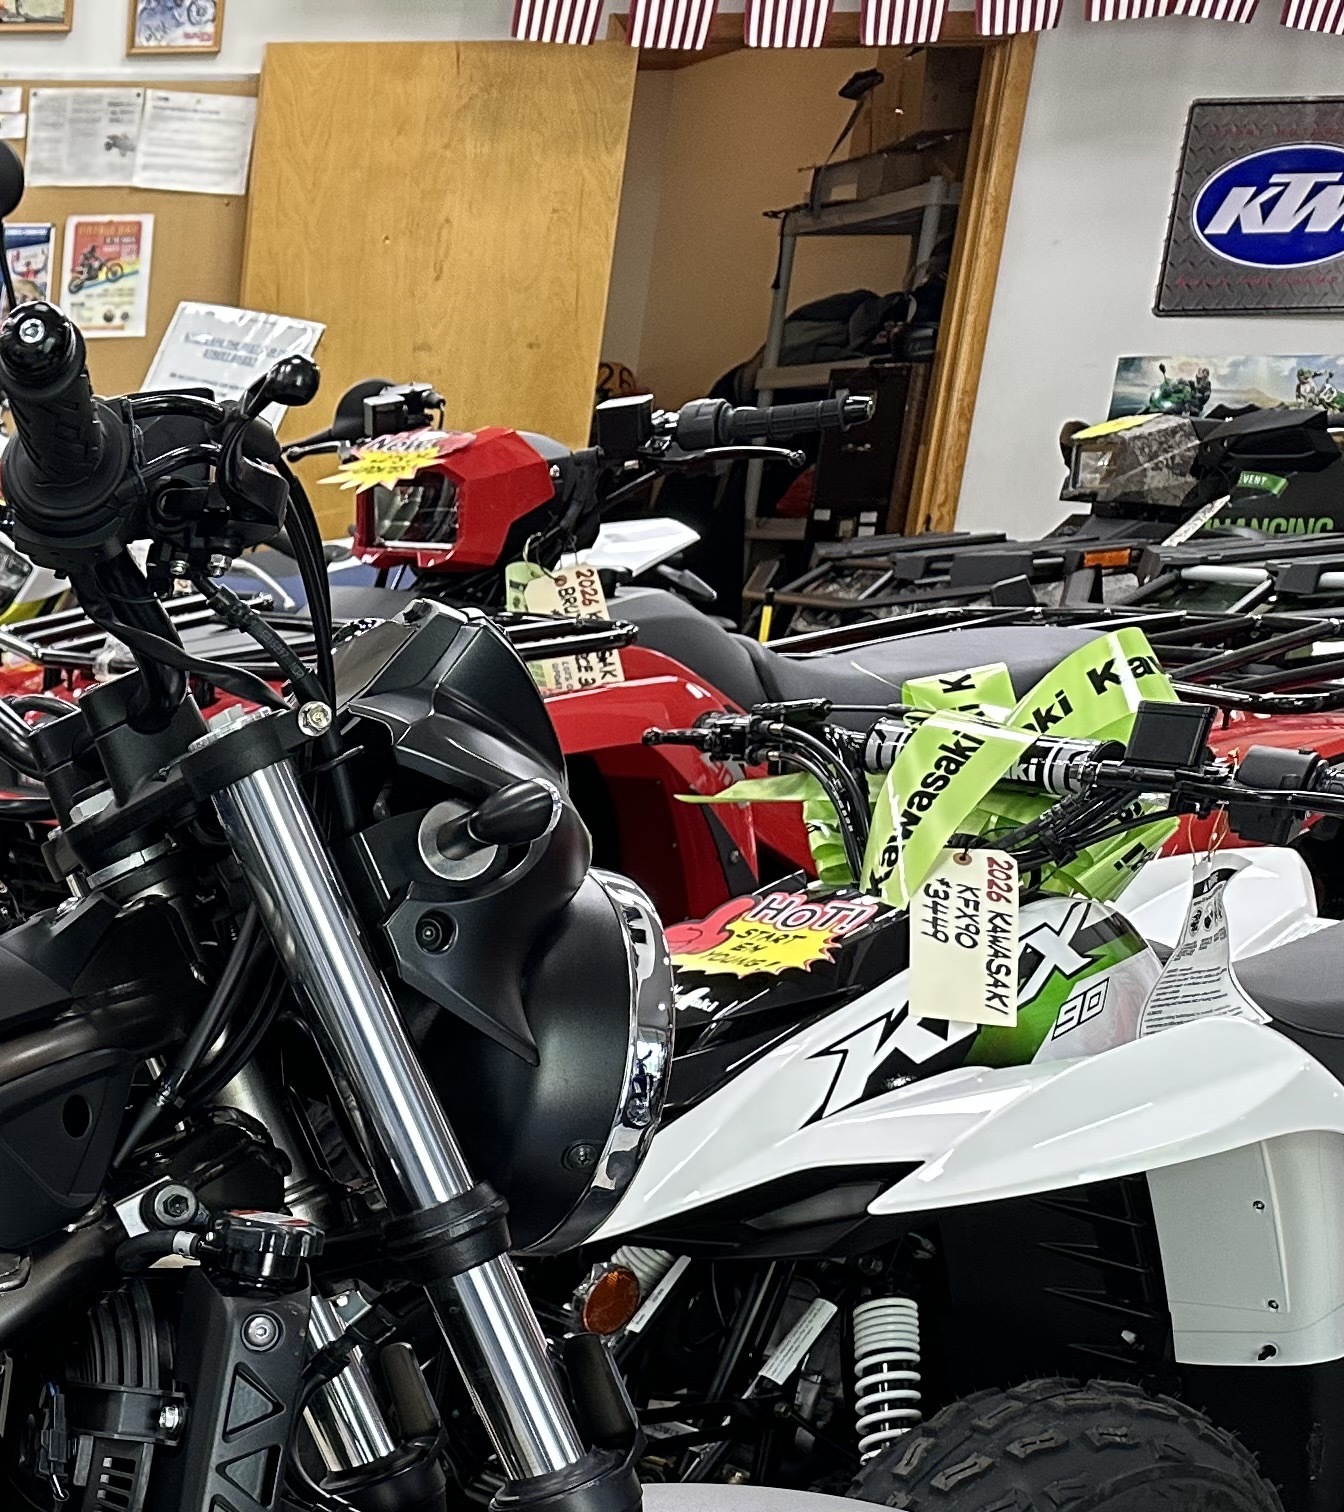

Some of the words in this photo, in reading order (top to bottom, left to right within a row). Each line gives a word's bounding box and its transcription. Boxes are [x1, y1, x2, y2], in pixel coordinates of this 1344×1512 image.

[575, 567, 602, 607] 2026
[986, 856, 1014, 904] 2026
[735, 928, 808, 945] START
[748, 896, 868, 933] HOT!
[955, 883, 982, 950] KFX90
[984, 909, 1014, 1016] KAWASAKI
[1051, 977, 1111, 1042] 90
